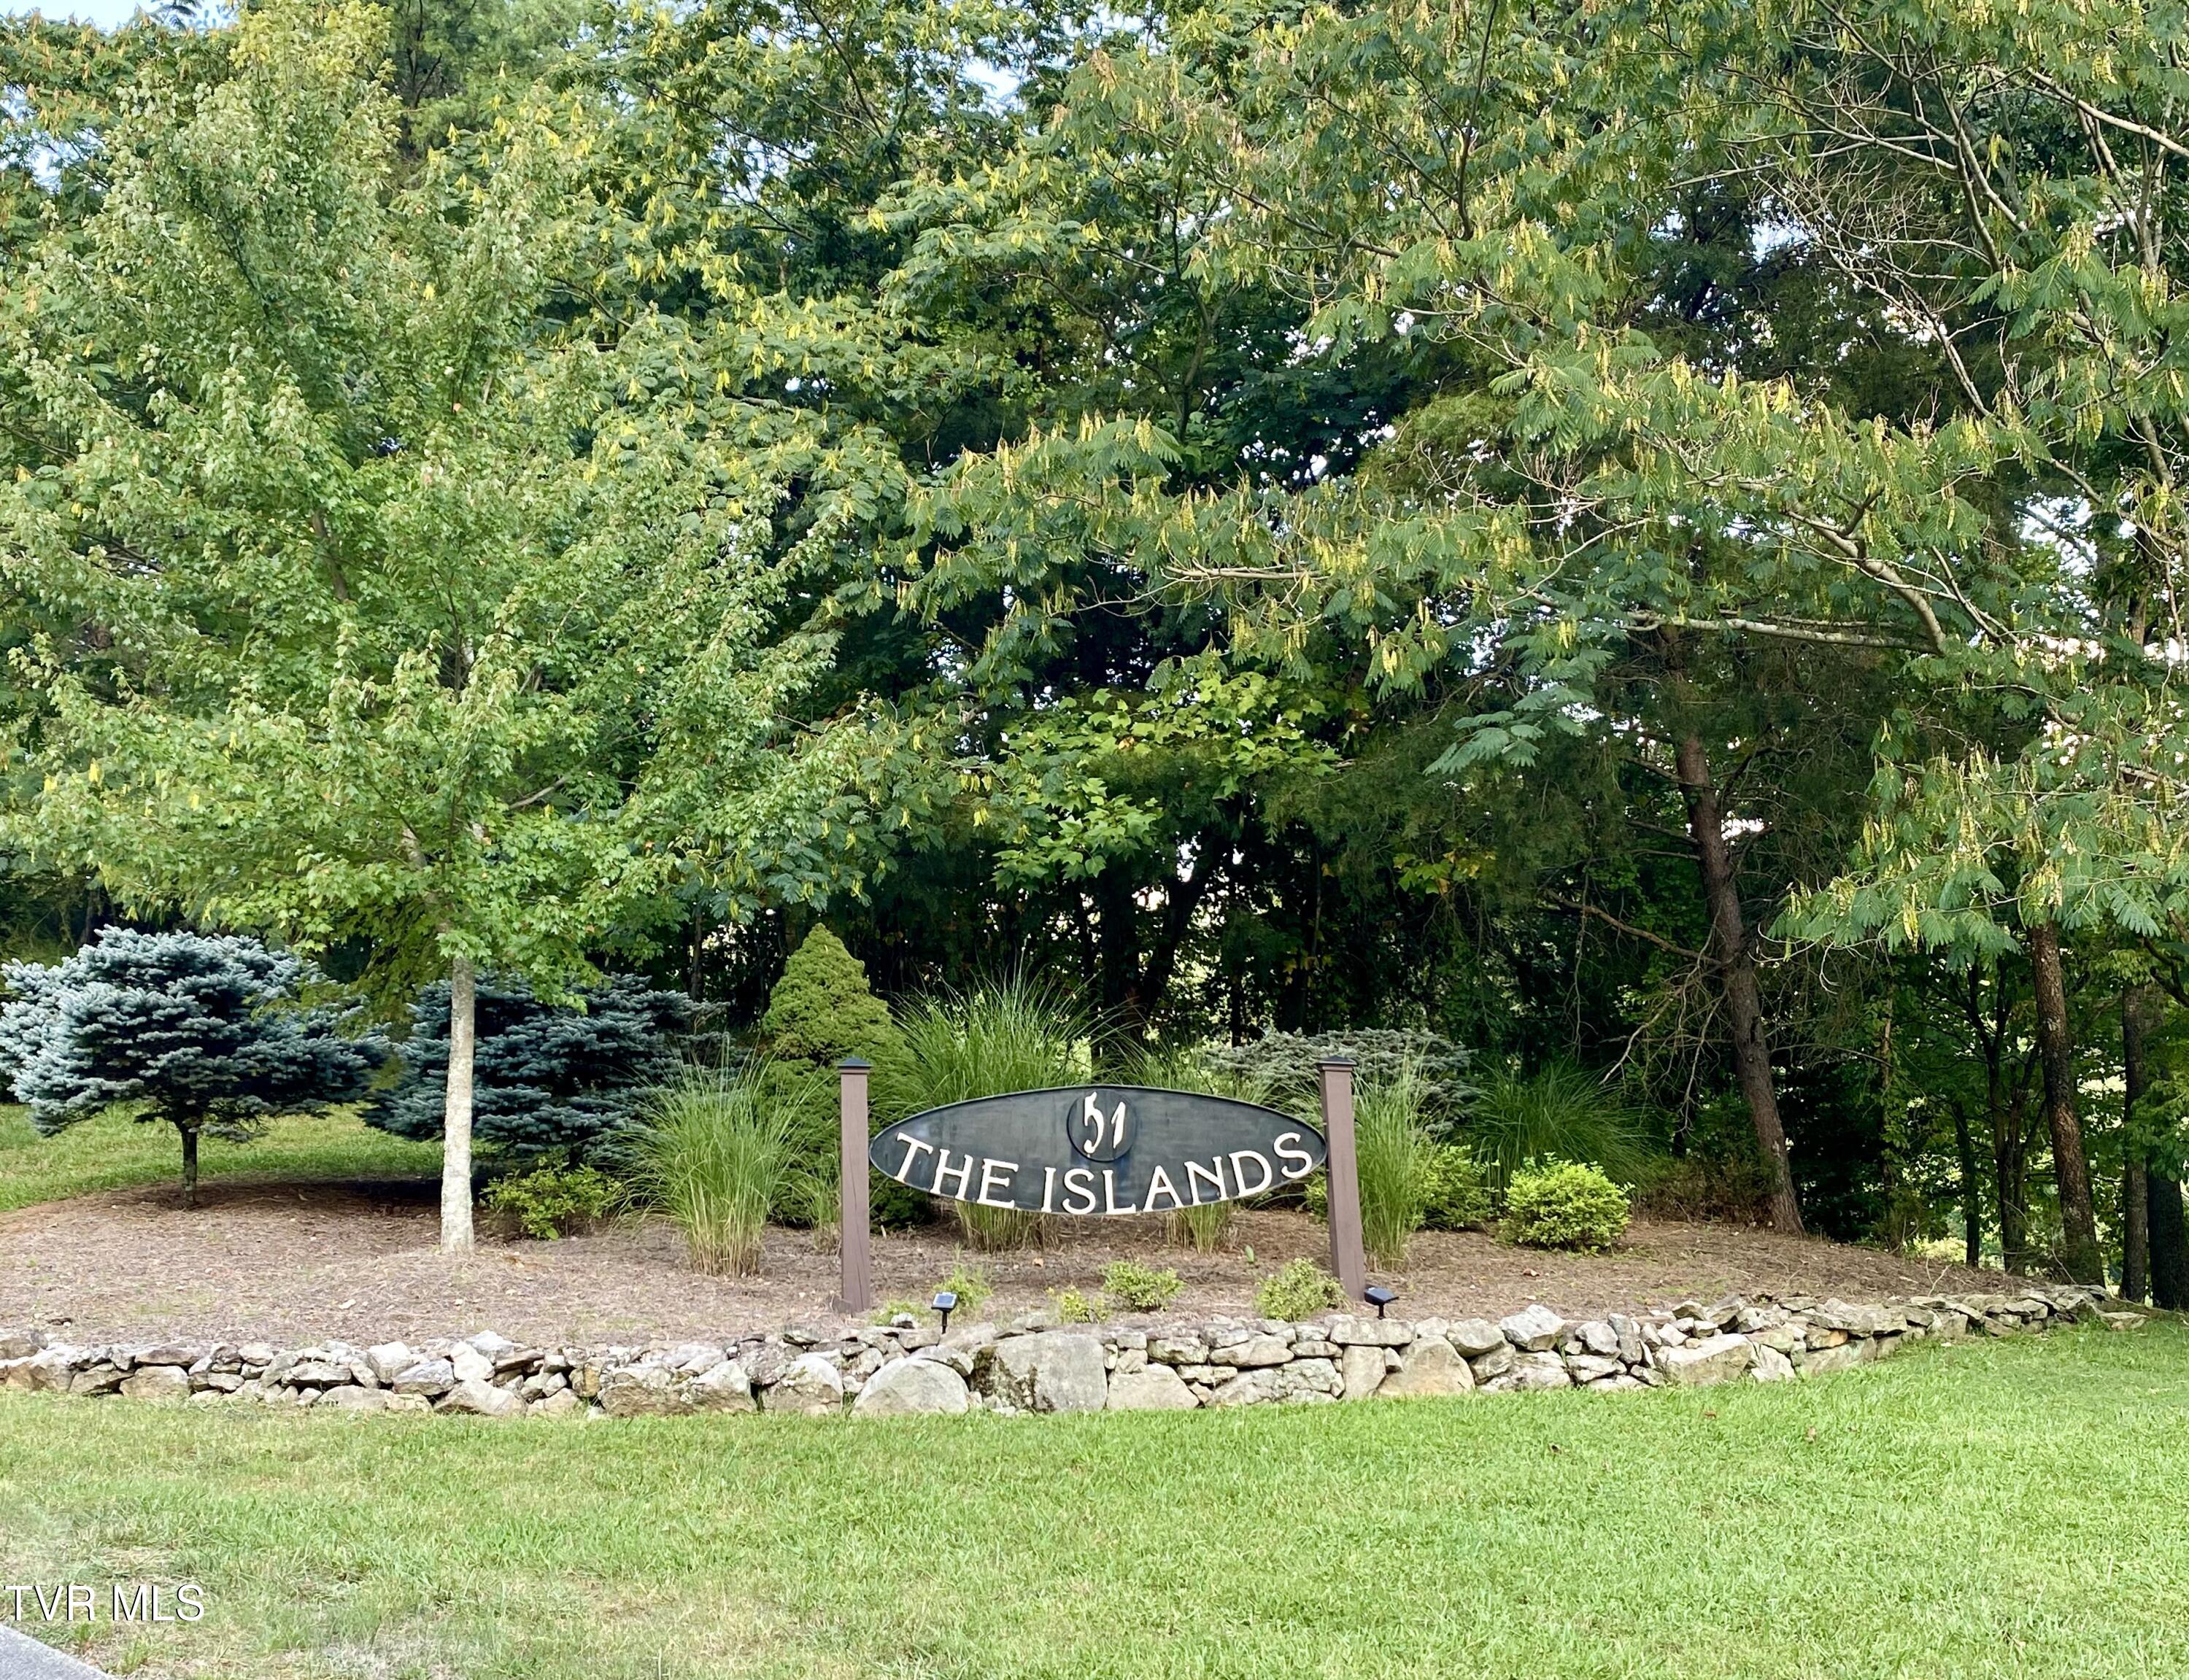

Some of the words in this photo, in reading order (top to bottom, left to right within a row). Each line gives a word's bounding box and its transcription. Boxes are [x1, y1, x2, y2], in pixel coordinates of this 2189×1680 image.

[1084, 1091, 1126, 1153] 51
[893, 1132, 1019, 1209] THE
[1041, 1132, 1313, 1215] ISLANDS
